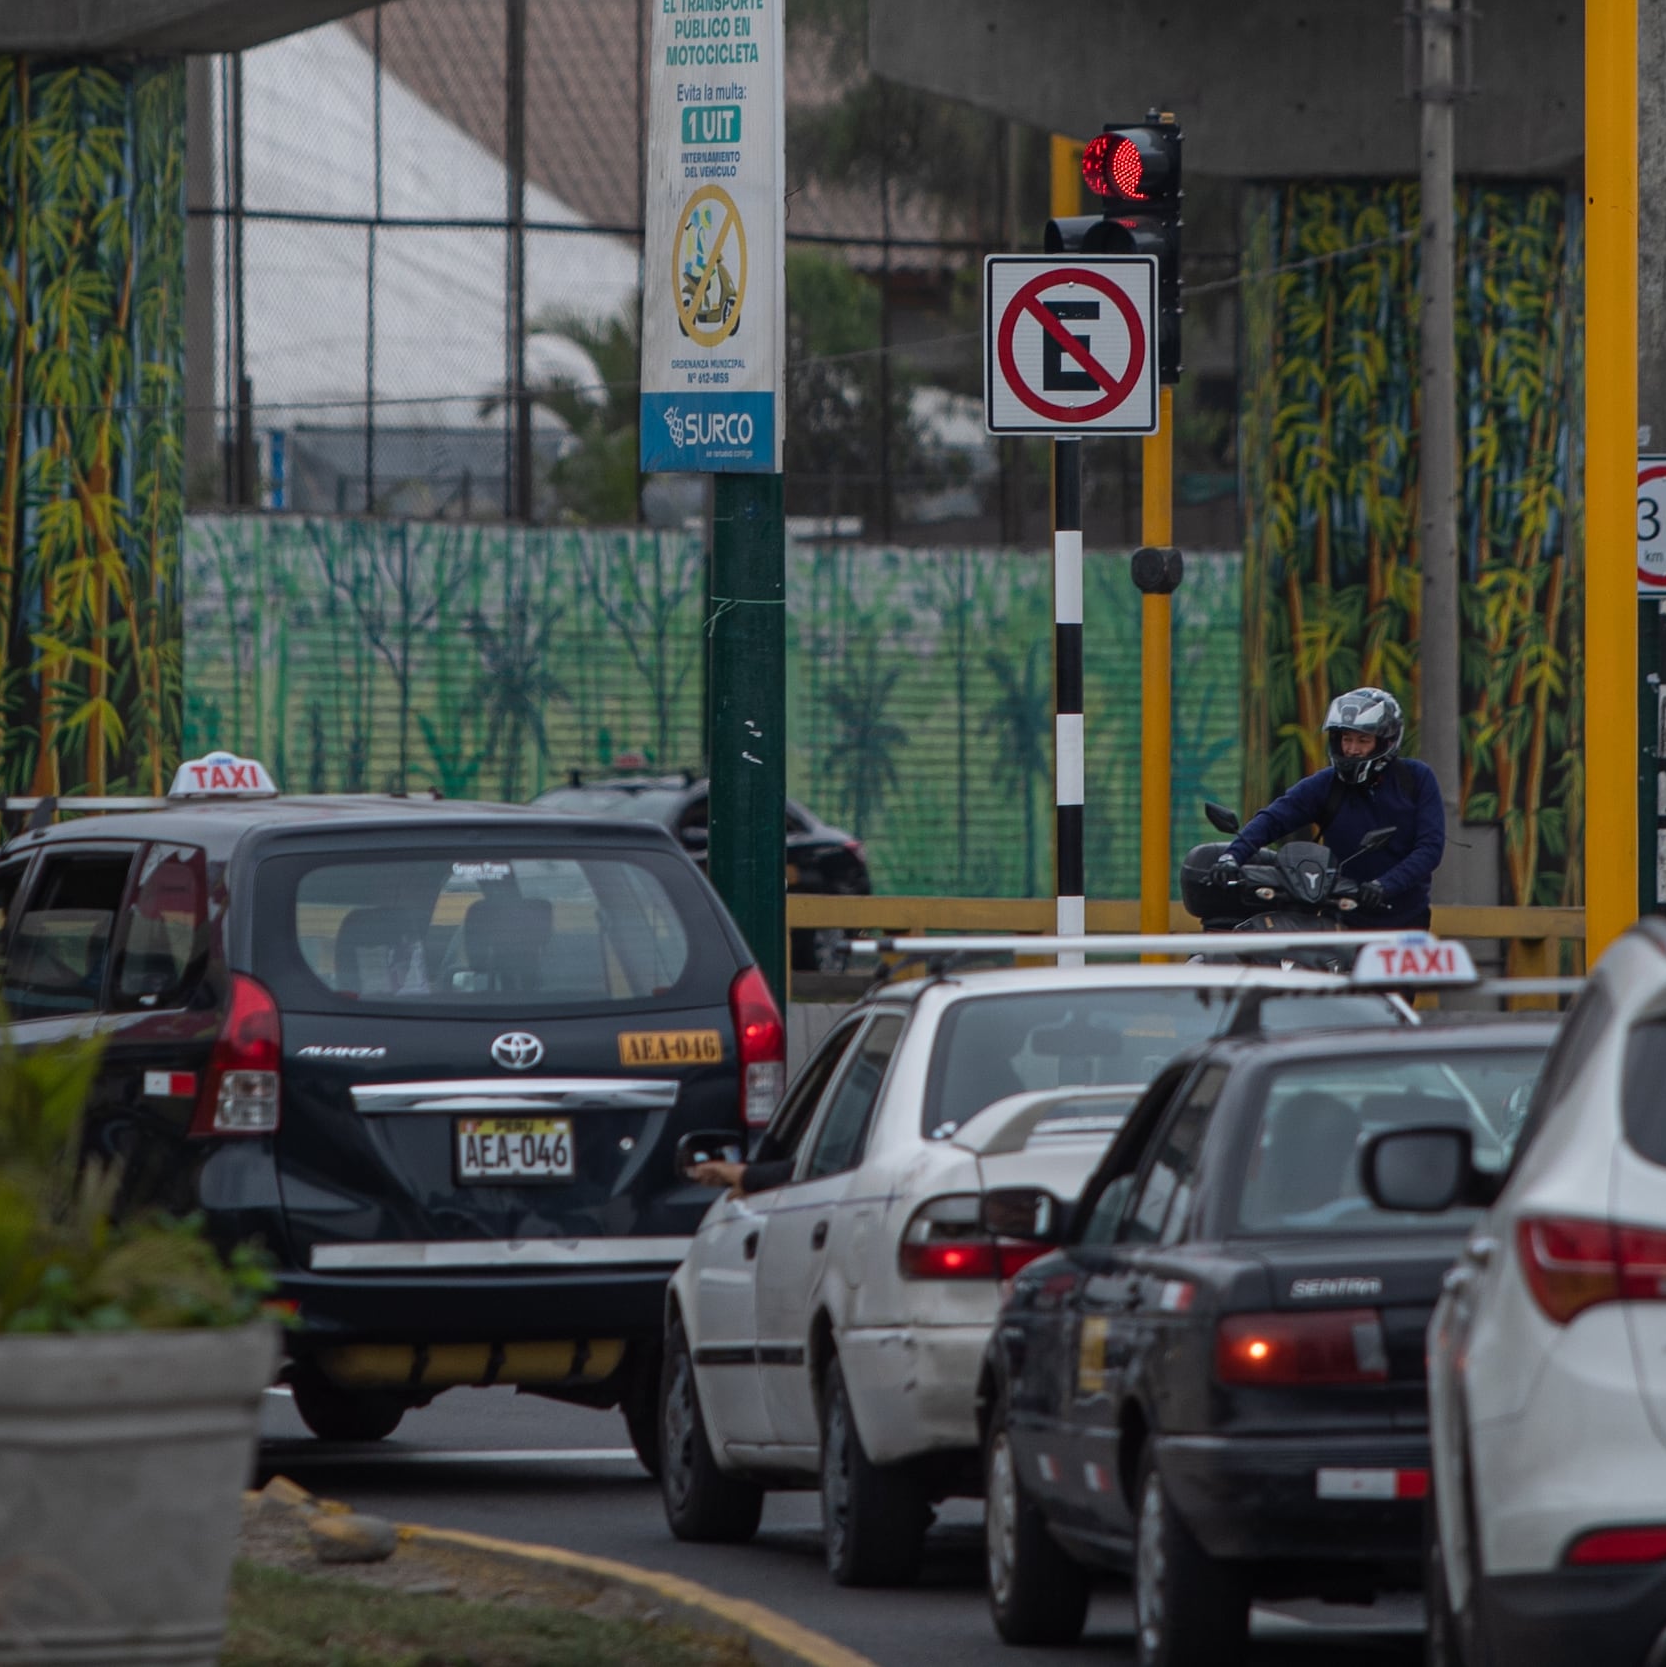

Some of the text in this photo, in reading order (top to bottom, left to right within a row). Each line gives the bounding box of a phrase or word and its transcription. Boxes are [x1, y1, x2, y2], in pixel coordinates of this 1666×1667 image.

[675, 14, 751, 39] PÚBLICO EN
[666, 42, 759, 66] MOTOCICLETA
[677, 81, 747, 102] Evita la multa:
[688, 110, 735, 141] 1 UIT
[681, 151, 741, 164] INTERNAMIENTO
[684, 164, 737, 178] DEL VEHÍCULO
[1042, 300, 1101, 392] E
[671, 359, 746, 370] ORDENANZA MUNICIPAL
[685, 413, 753, 446] SURCO
[190, 765, 260, 789] TAXI
[1378, 947, 1455, 974] TAXI
[625, 1036, 717, 1062] AEA-046
[465, 1134, 569, 1168] AEA-046
